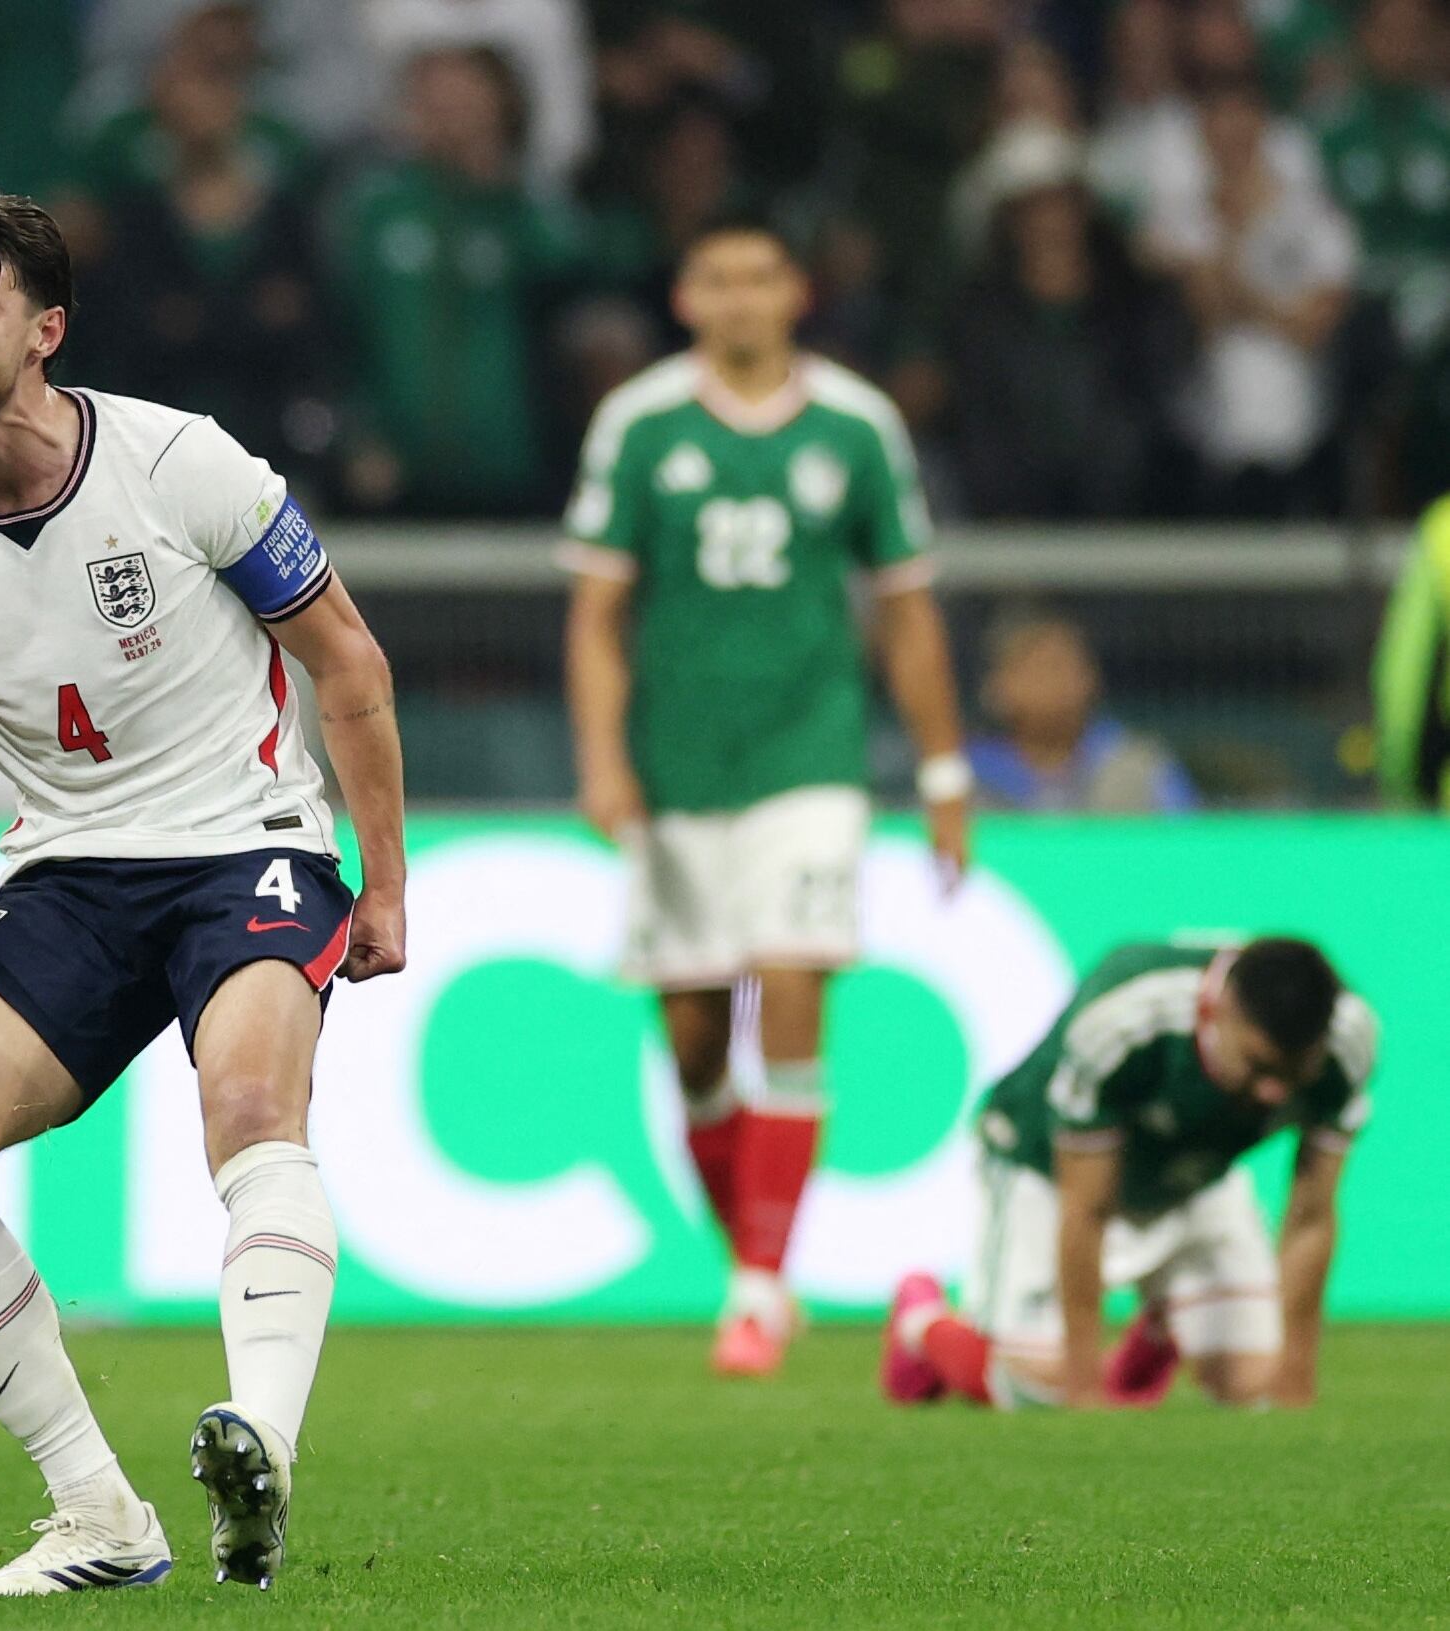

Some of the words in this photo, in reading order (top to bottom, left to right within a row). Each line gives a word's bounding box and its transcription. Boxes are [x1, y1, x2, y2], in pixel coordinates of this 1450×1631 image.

[262, 504, 297, 553] FOOTBALL
[268, 513, 307, 566] UNITES
[277, 559, 297, 580] the
[118, 625, 157, 649] MEXICO
[124, 638, 162, 661] 05.07.26
[58, 683, 113, 764] 4
[255, 858, 302, 914] 4
